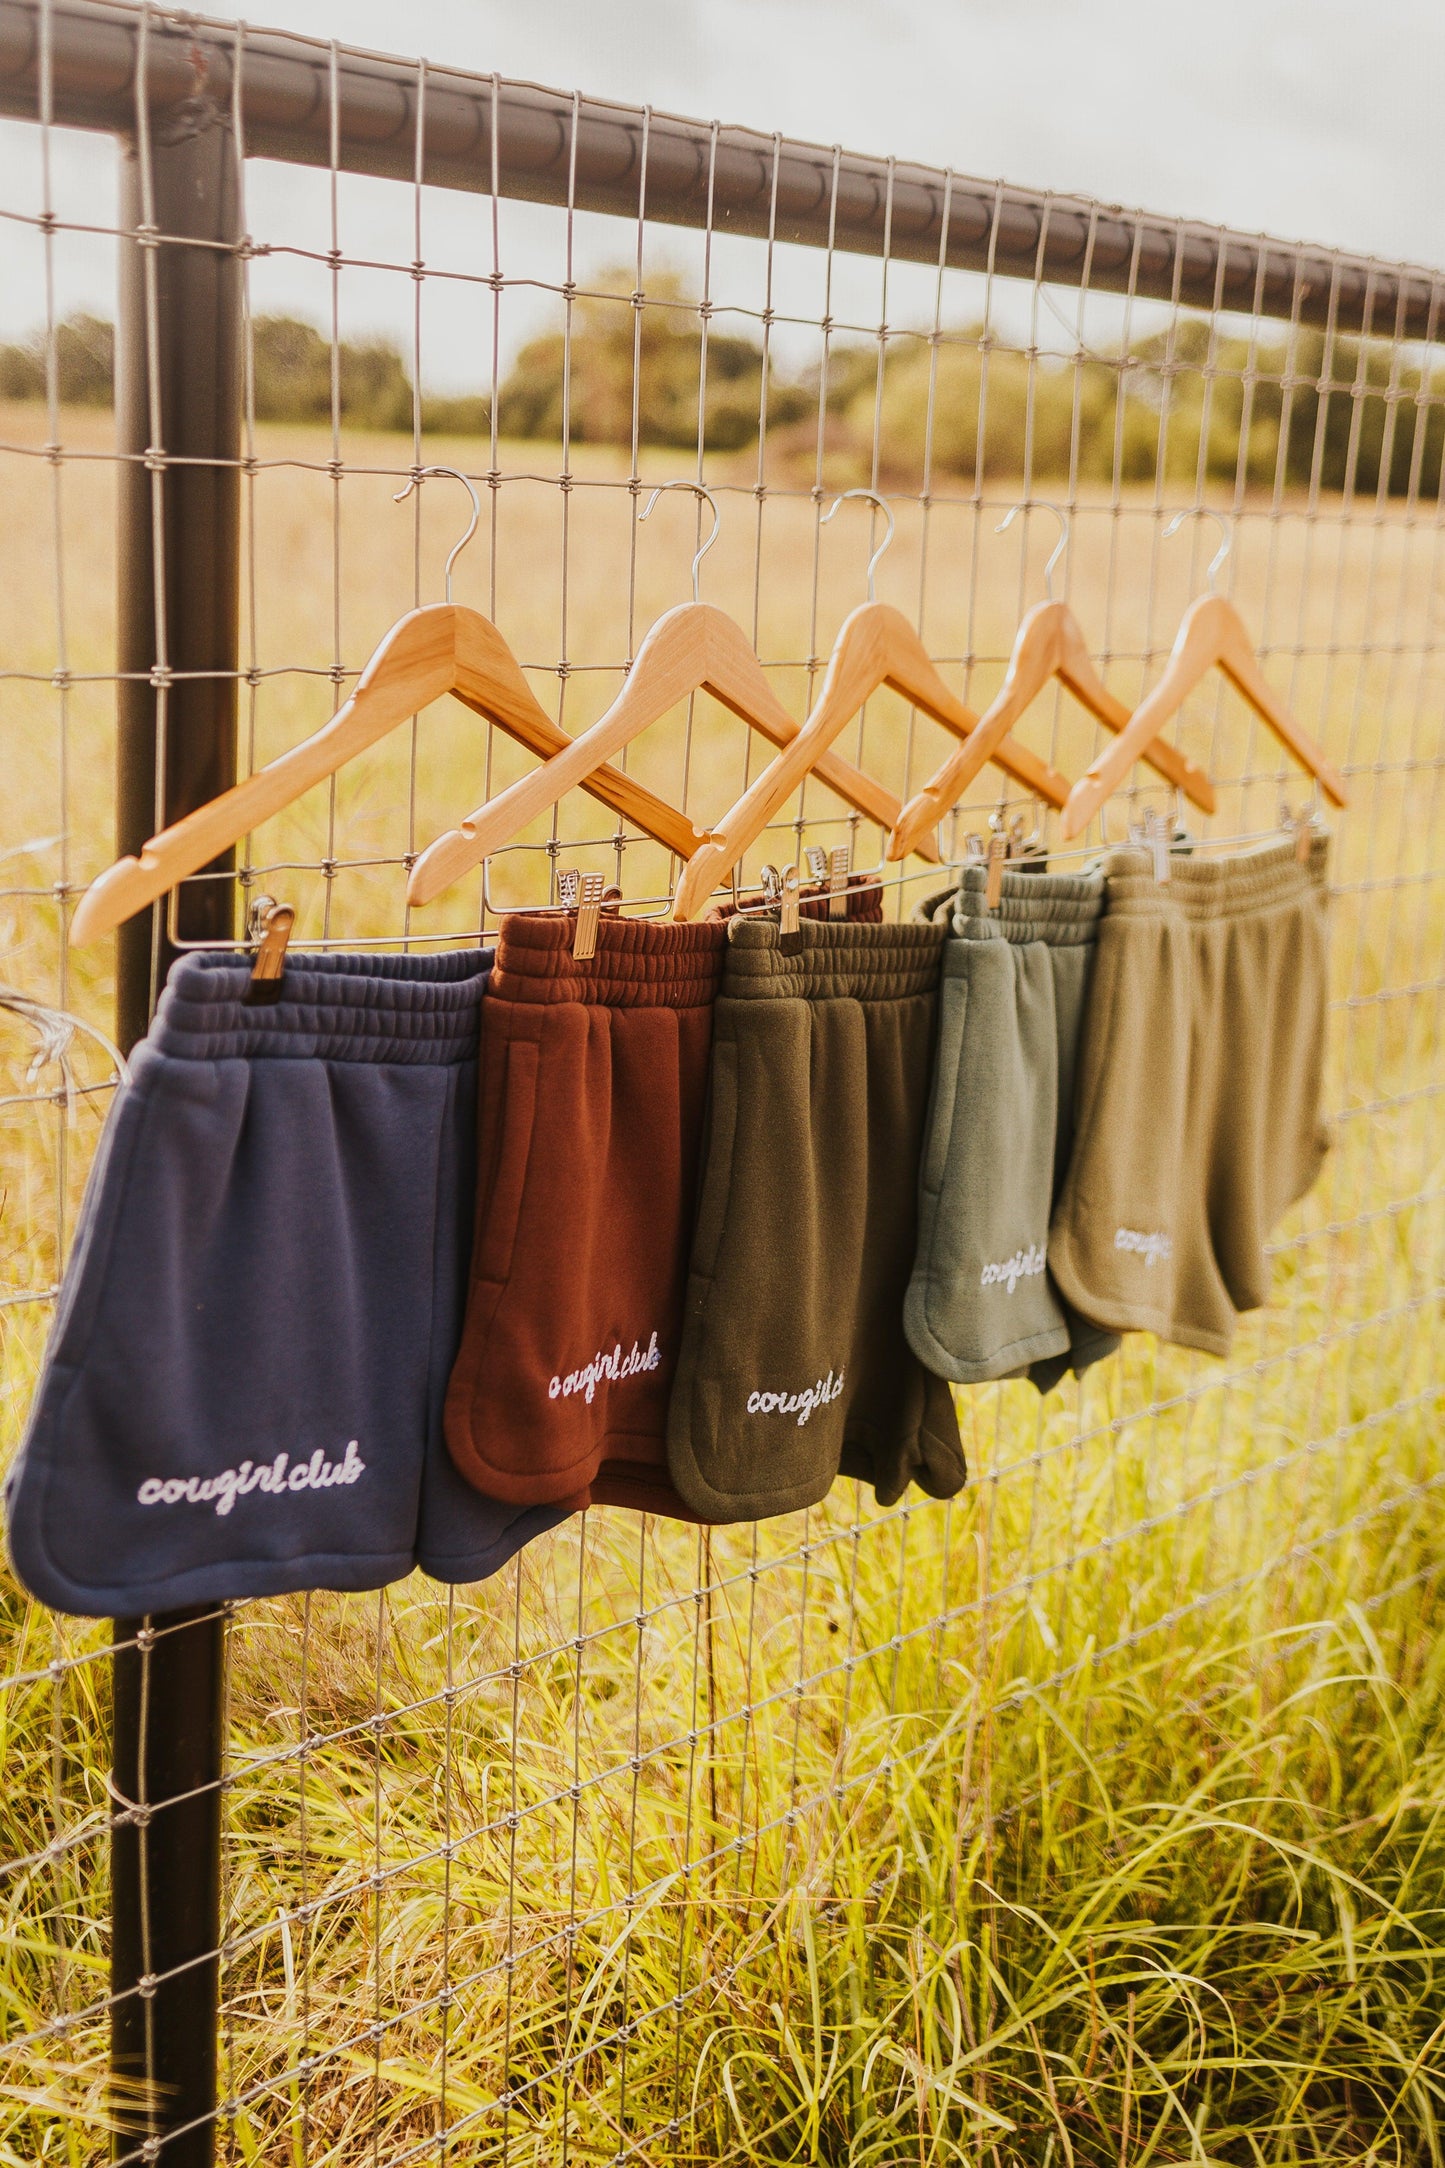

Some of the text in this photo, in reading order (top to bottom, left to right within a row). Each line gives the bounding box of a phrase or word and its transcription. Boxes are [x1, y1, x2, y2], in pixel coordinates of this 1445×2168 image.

[548, 1330, 663, 1404] cowgirl club
[137, 1439, 366, 1516] cowgirl club
